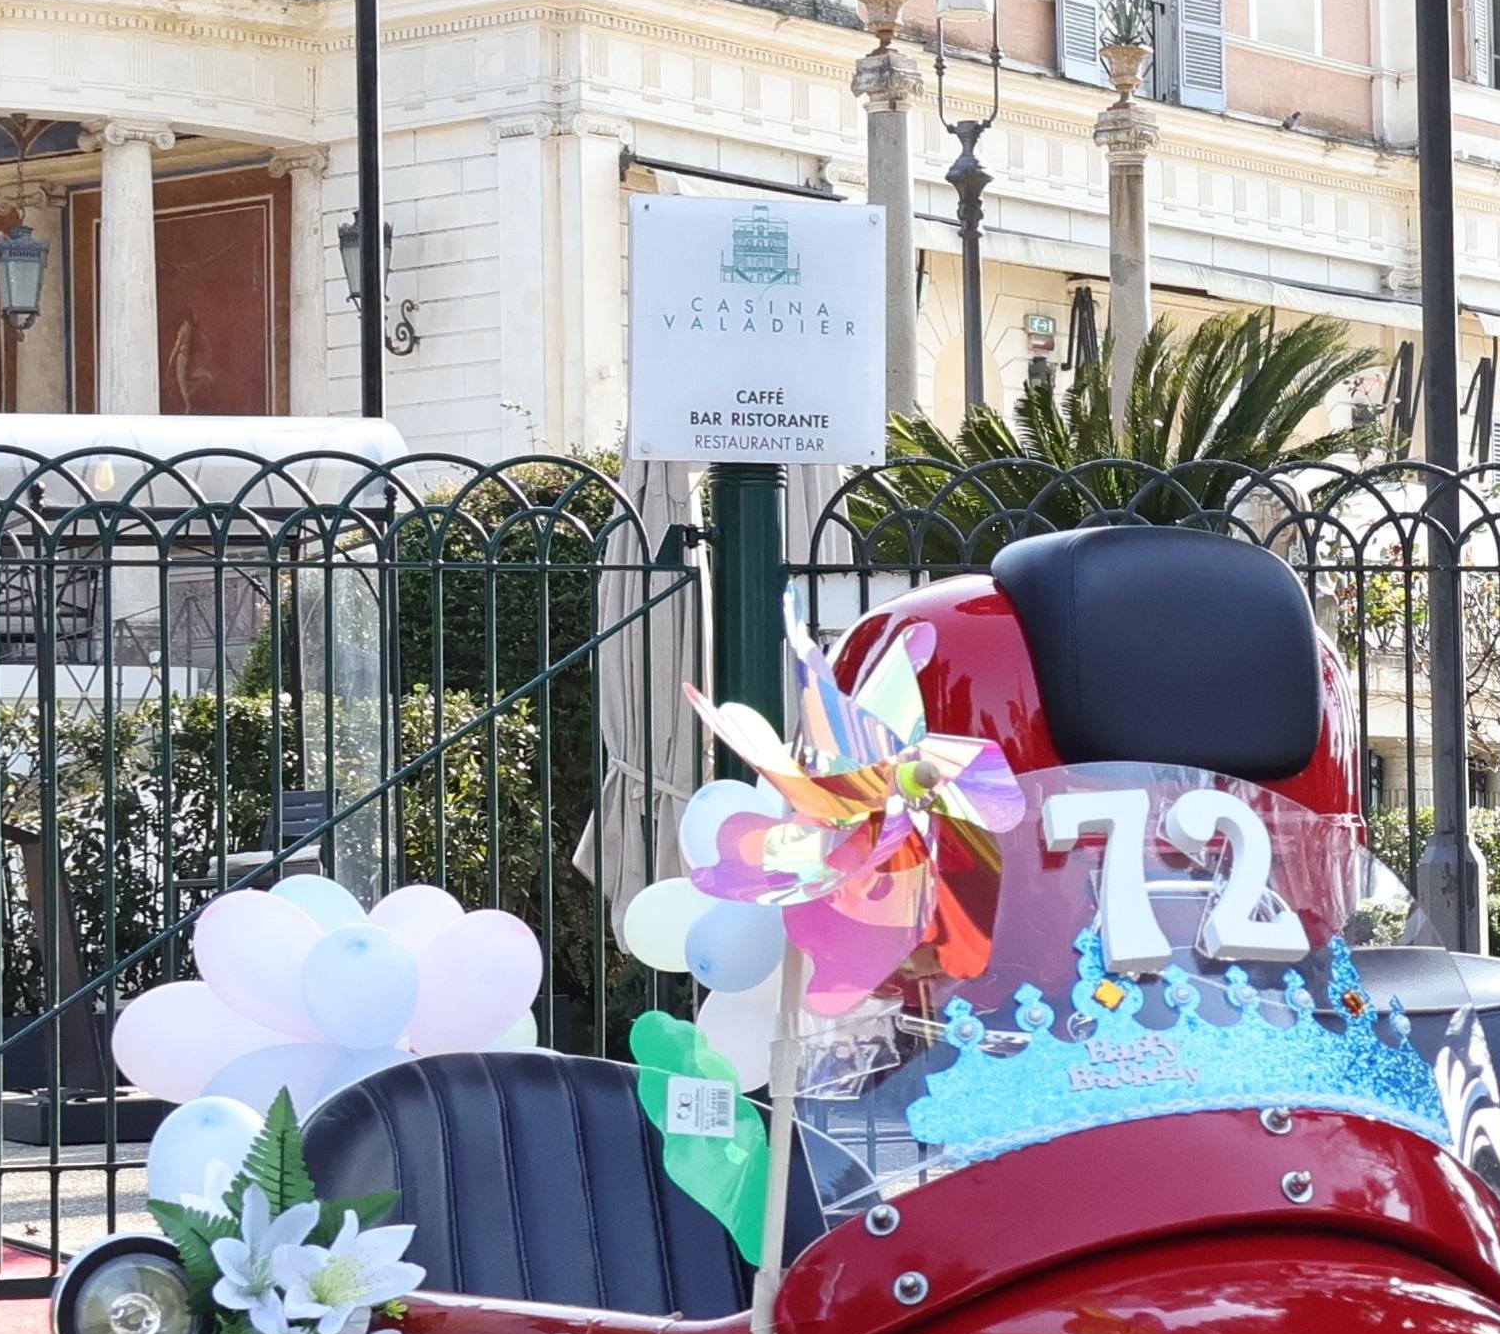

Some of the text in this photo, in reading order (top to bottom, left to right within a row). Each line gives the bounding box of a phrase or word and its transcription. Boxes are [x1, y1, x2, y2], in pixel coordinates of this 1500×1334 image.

[690, 297, 829, 317] CASINA
[663, 314, 856, 336] VALADIER
[736, 387, 784, 405] CAFFÉ
[690, 411, 829, 429] BAR RISTORANTE
[694, 435, 824, 452] RESTAURANT BAR
[1041, 788, 1311, 974] 72
